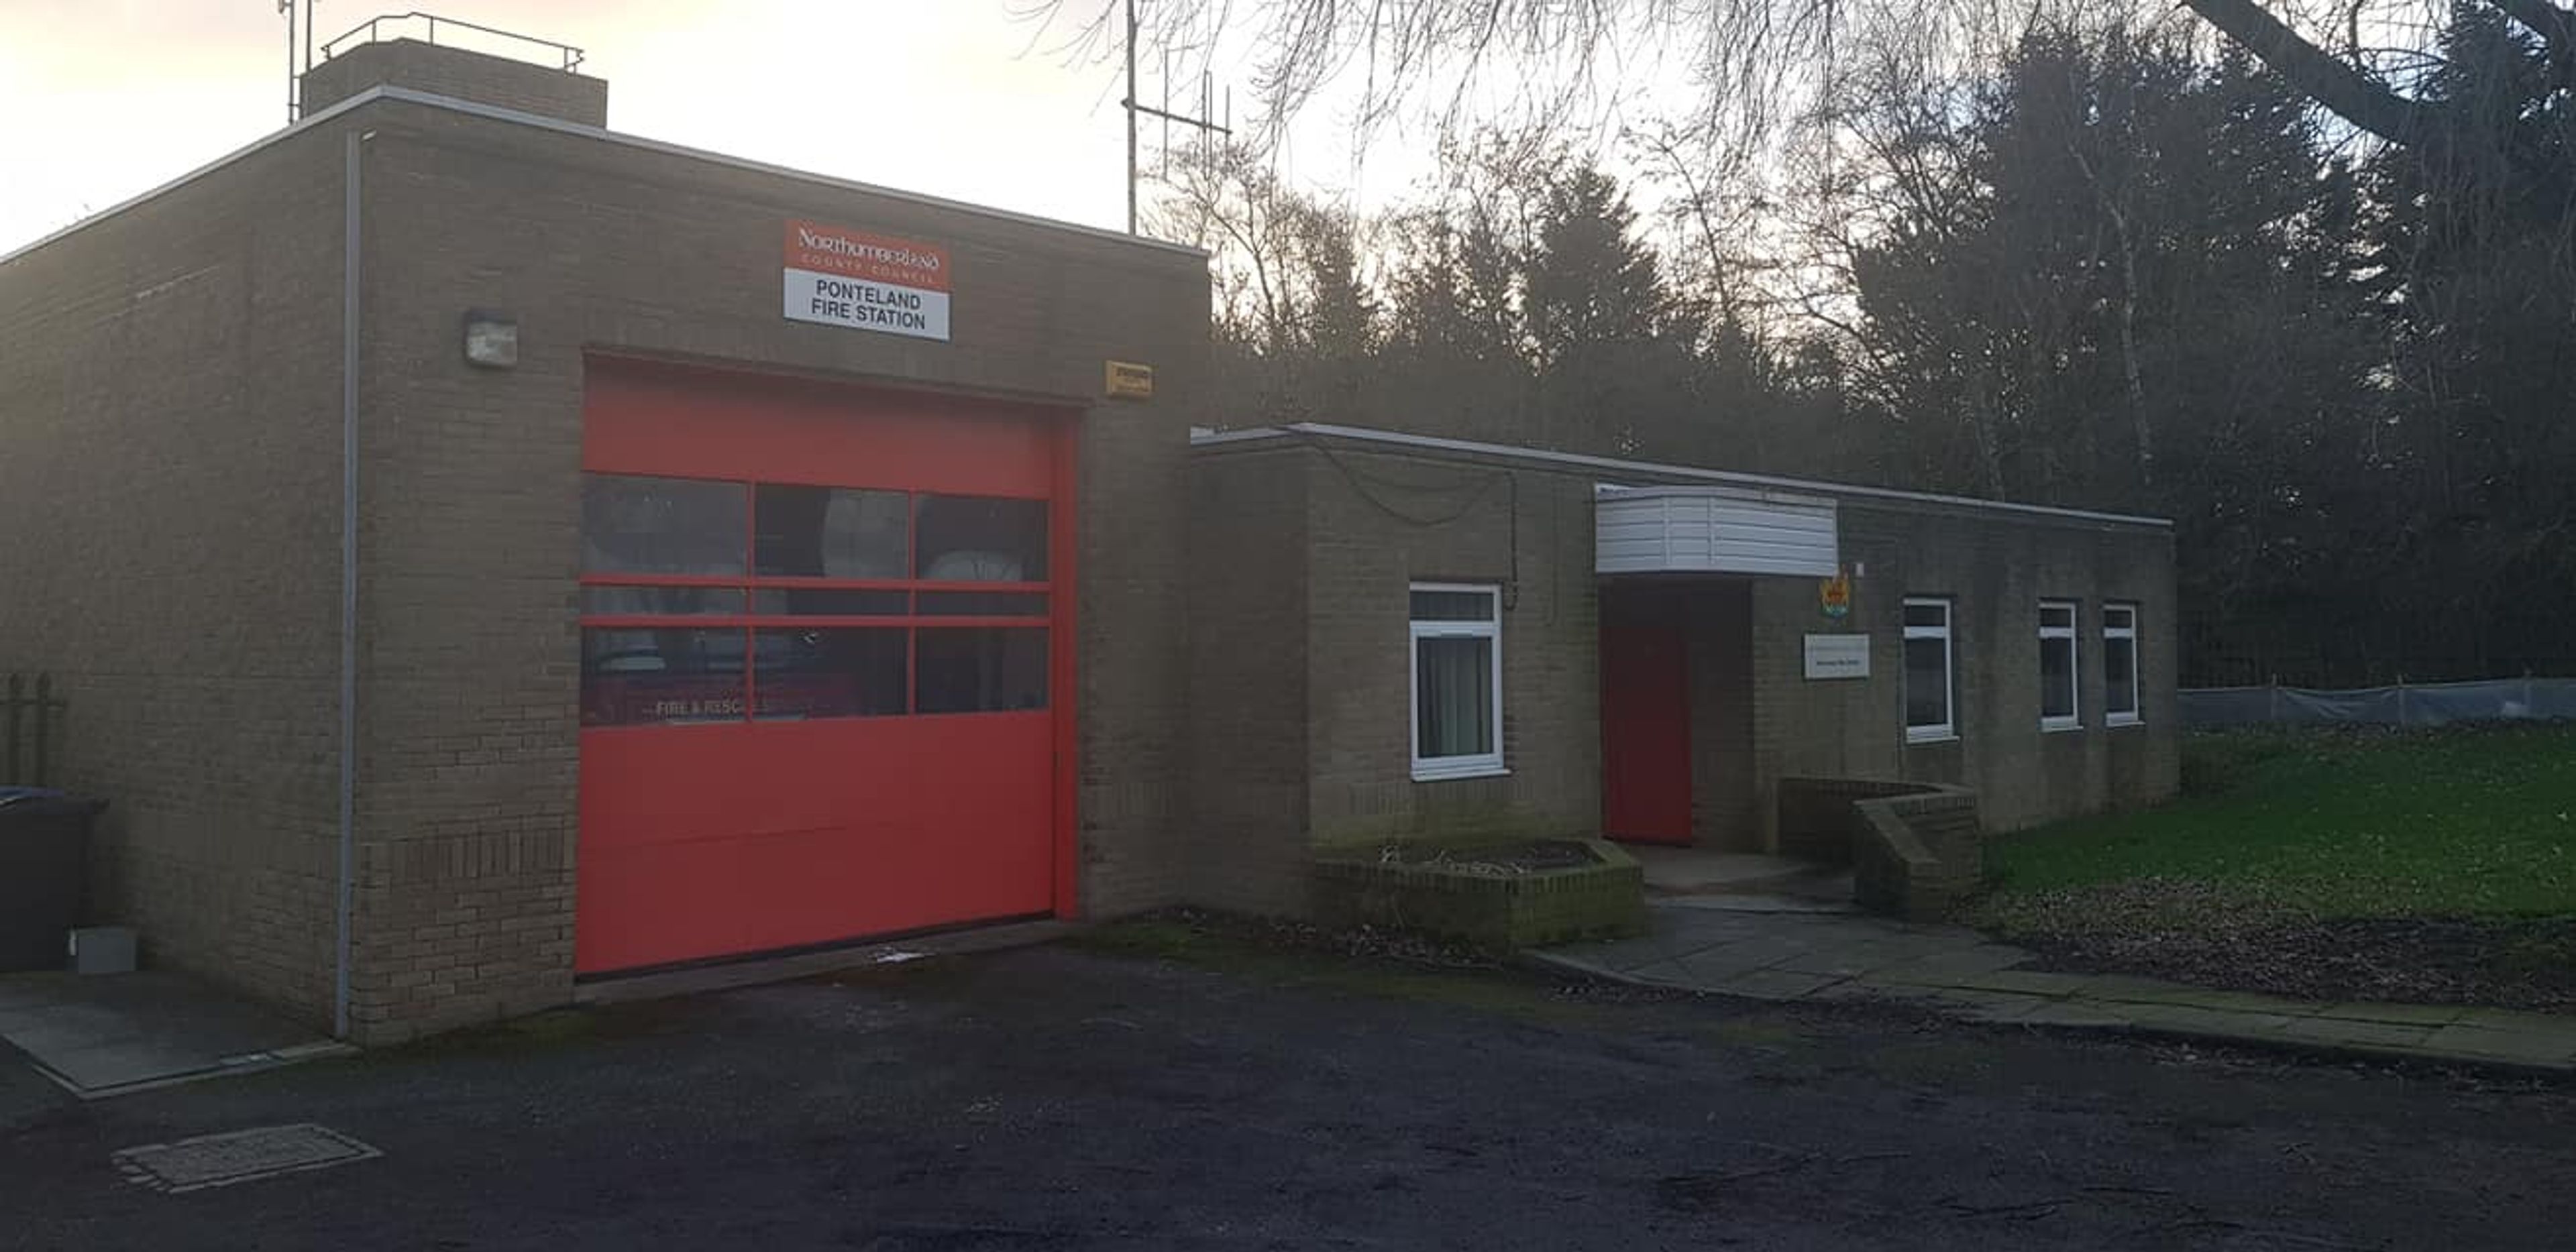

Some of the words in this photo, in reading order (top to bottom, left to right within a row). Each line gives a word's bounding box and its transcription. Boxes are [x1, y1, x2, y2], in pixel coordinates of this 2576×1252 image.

[801, 253, 862, 270] COUNTY
[872, 265, 932, 282] COUNCIL
[816, 280, 920, 310] PONTELAND
[812, 298, 850, 319] FIRE
[857, 304, 925, 330] STATION
